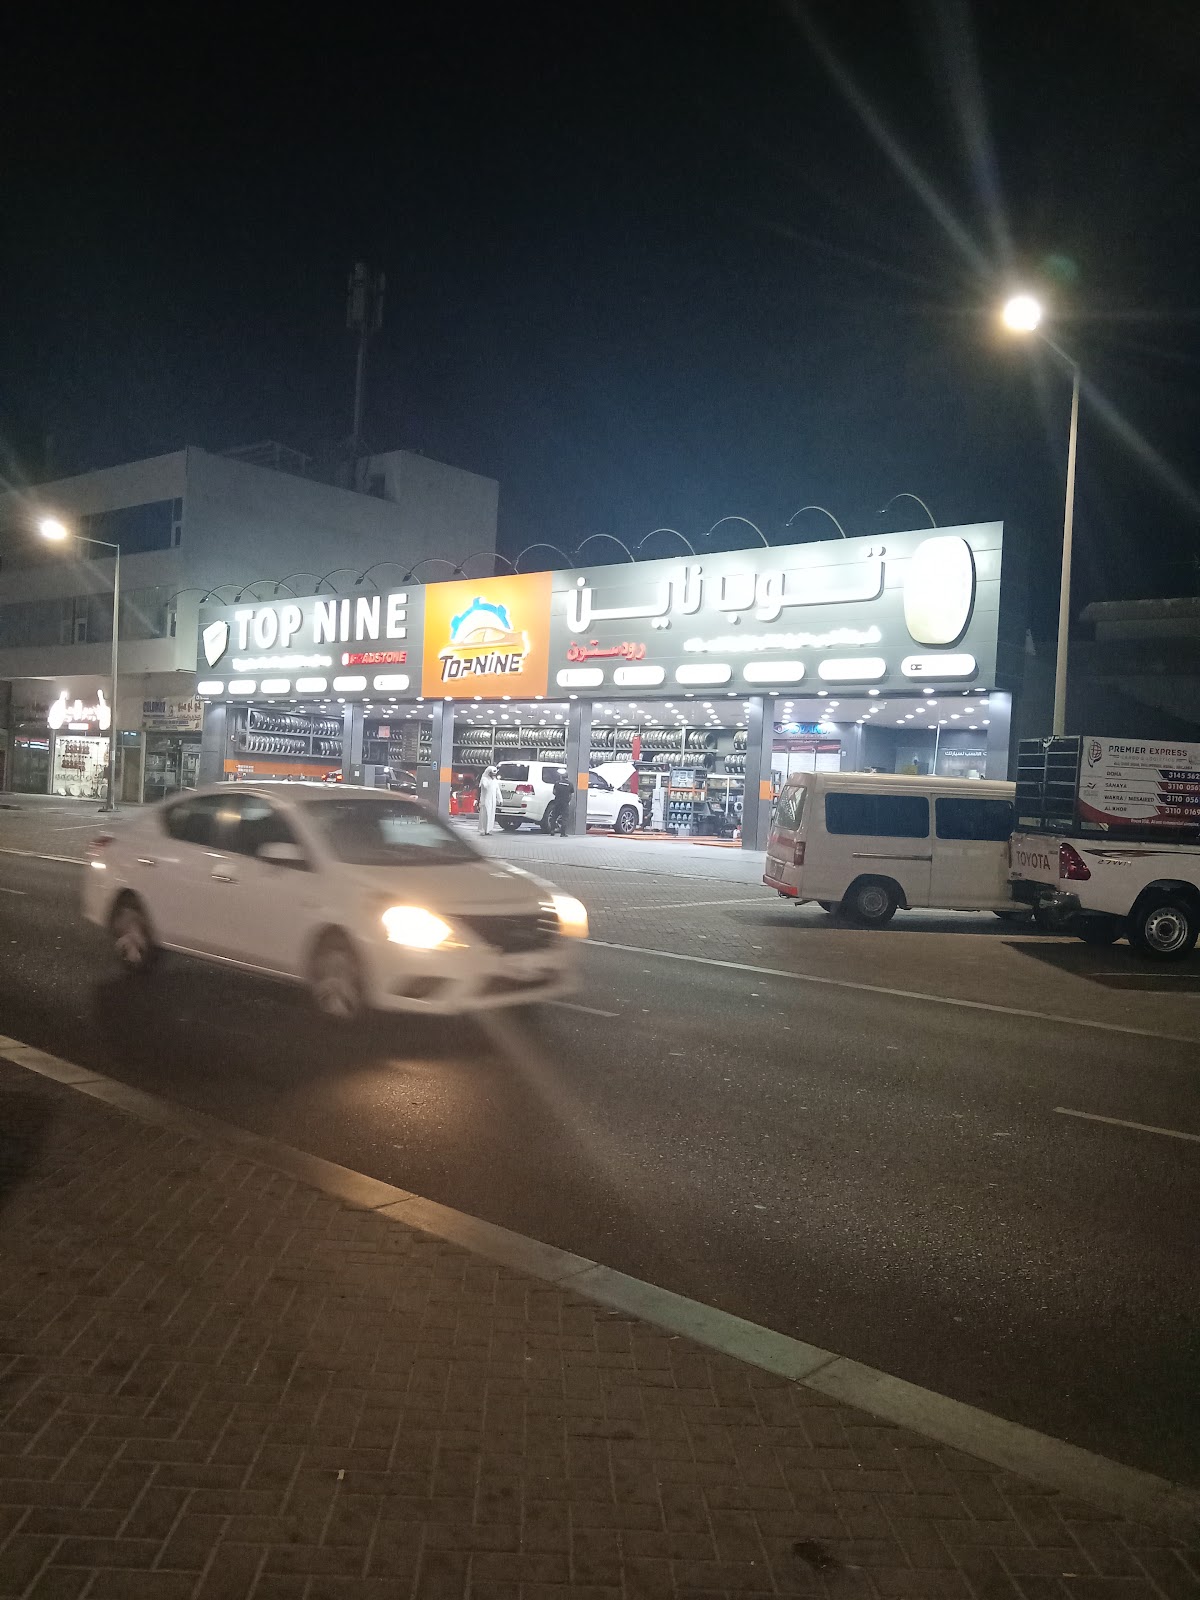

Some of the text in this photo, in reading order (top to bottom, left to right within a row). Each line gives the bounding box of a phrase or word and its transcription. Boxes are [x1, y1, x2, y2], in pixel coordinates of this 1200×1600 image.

[235, 593, 409, 649] TOP NINE
[1108, 745, 1188, 757] PREMIER EXPRESS
[1016, 851, 1051, 871] TOYOTA
